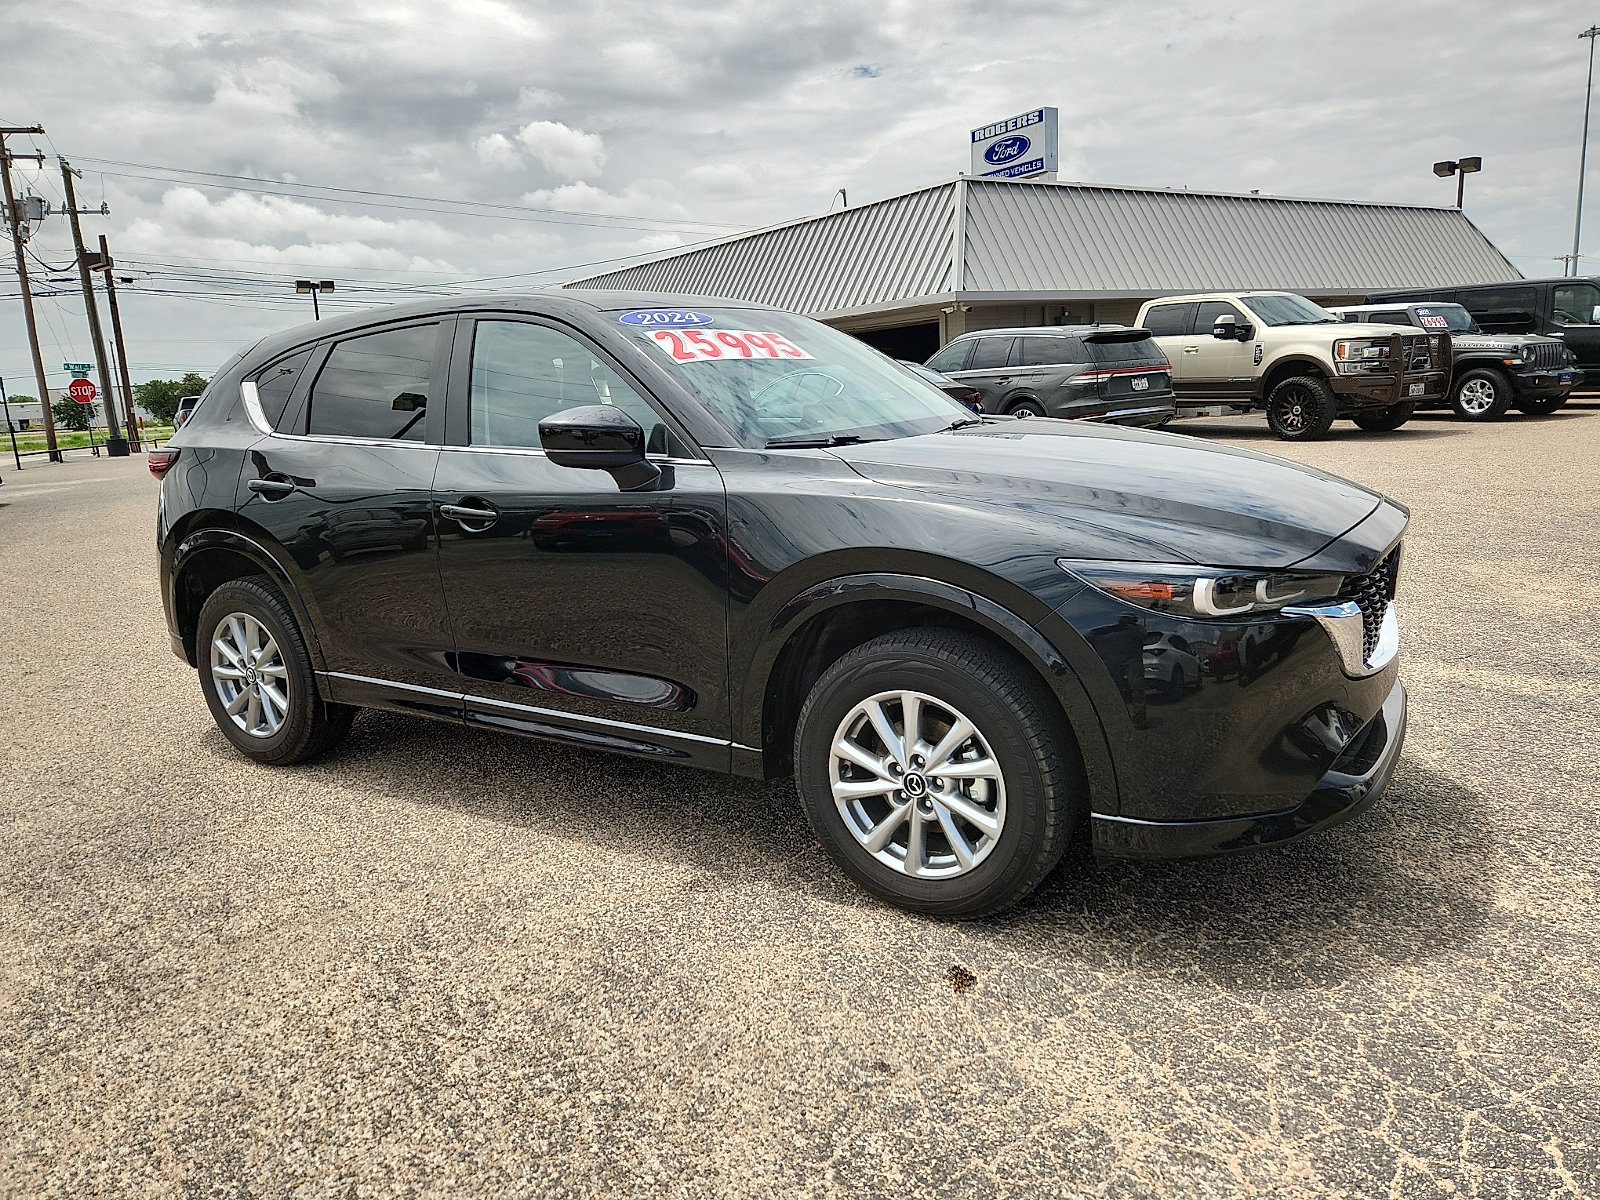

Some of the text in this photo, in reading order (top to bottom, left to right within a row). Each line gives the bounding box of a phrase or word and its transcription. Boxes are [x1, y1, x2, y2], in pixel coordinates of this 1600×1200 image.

[975, 112, 1039, 141] ROGERS
[993, 140, 1020, 161] Ford
[1011, 161, 1042, 175] VEHICLES
[637, 311, 702, 325] 2024
[1421, 317, 1446, 327] 26995
[654, 330, 803, 360] 25995
[71, 386, 94, 396] STOP
